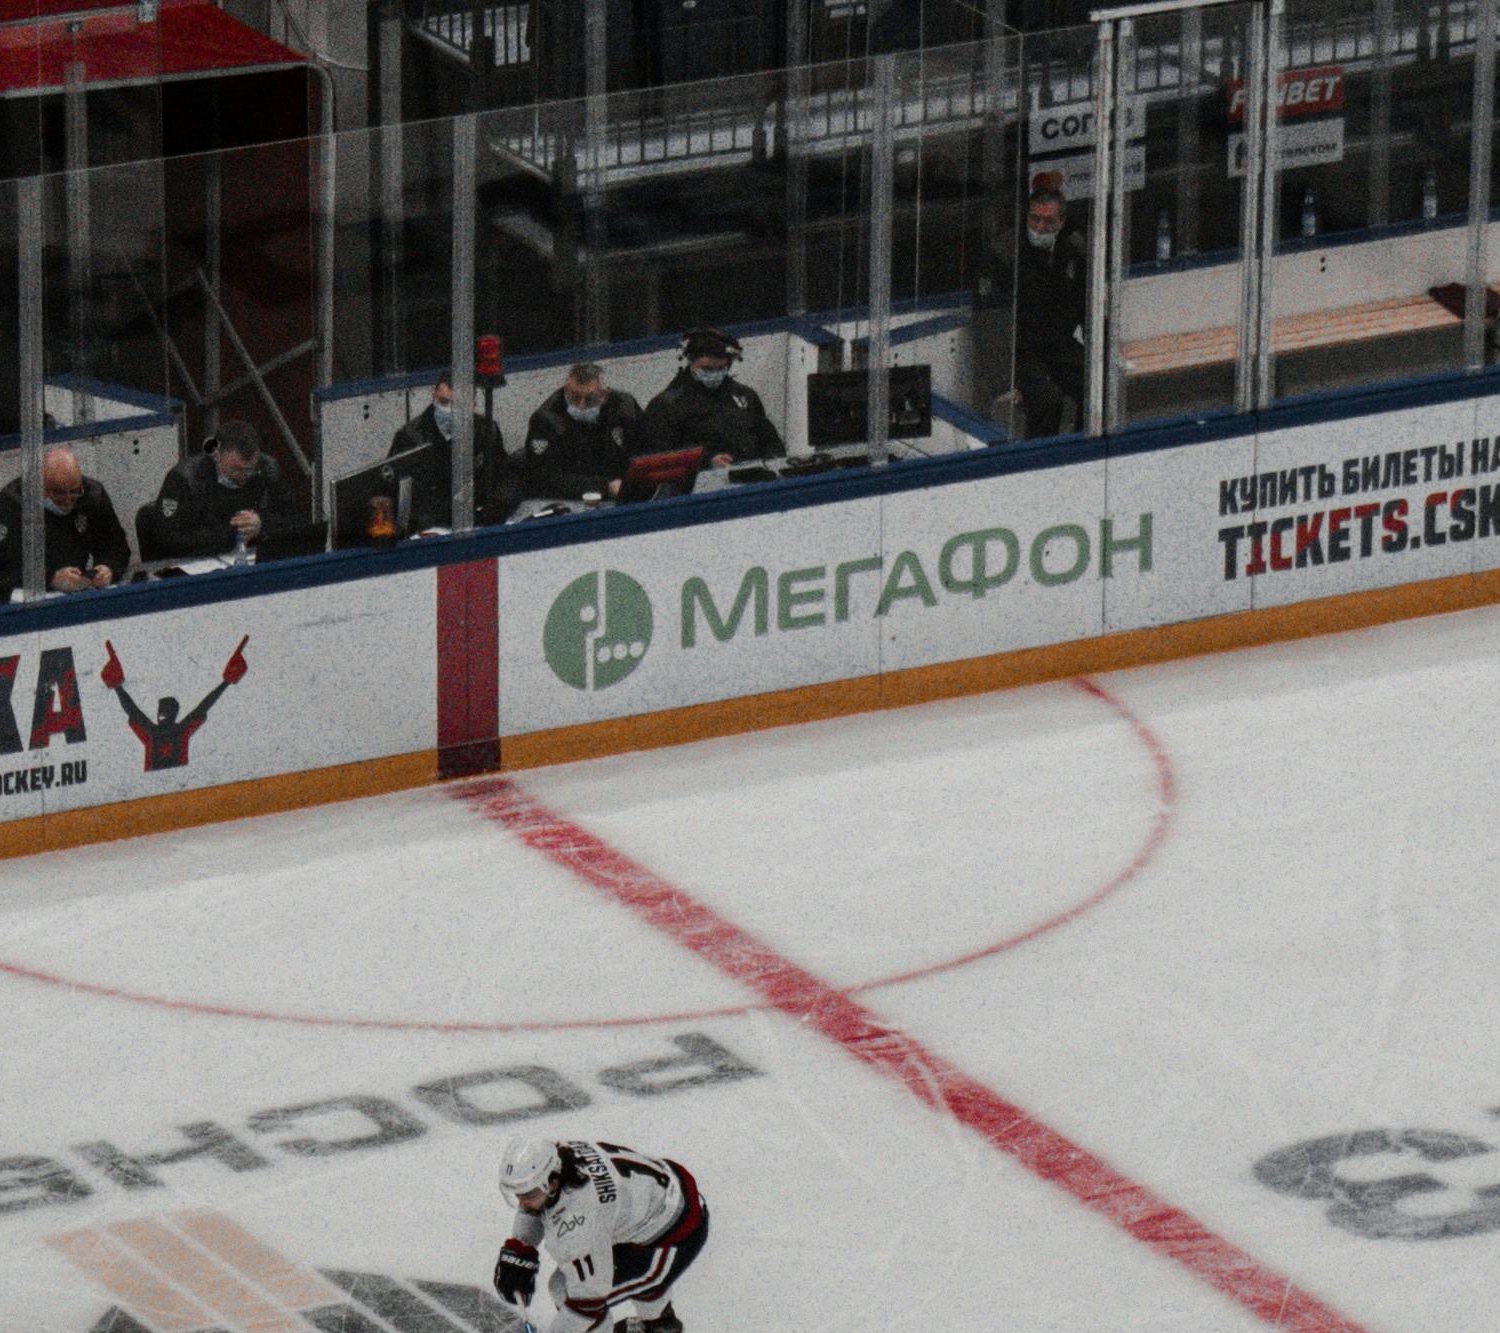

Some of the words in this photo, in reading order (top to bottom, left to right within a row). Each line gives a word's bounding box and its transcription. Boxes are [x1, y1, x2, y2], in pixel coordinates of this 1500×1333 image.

[1219, 463, 1335, 517] КУПИТЬ
[1343, 442, 1464, 496] БИЛЕТЫ
[681, 513, 1154, 649] МЕГАФОН
[573, 1254, 595, 1281] 11
